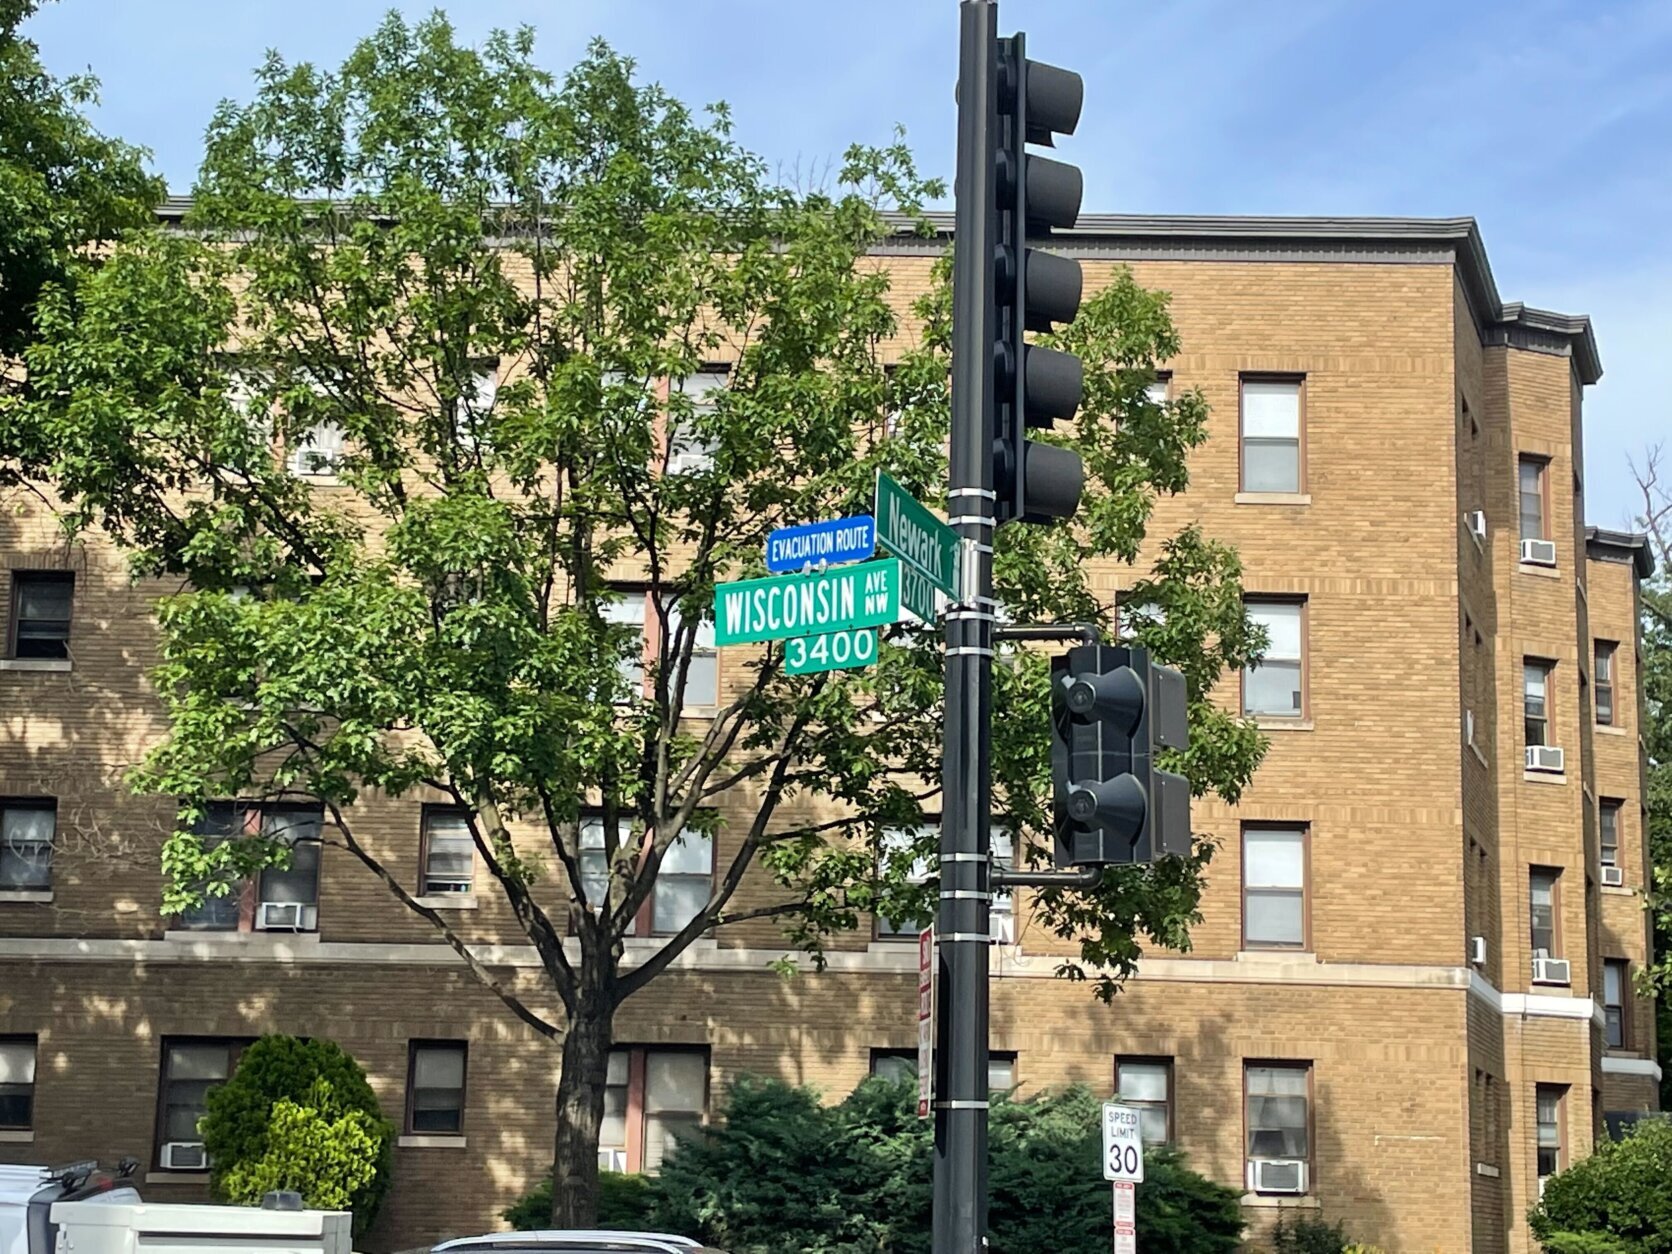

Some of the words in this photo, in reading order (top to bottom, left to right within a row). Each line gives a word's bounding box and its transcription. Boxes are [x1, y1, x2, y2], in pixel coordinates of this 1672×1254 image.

[772, 533, 833, 562] EVACUATION
[836, 525, 869, 550] ROUTE
[889, 491, 943, 580] Newark
[865, 570, 887, 594] AVE
[903, 565, 934, 620] 3700
[725, 575, 855, 635] WISCONSIN
[865, 593, 889, 616] NW
[790, 629, 873, 668] 3400
[1108, 1111, 1137, 1125] SPEED
[1111, 1127, 1135, 1139] LIMIT
[1109, 1144, 1138, 1174] 30
